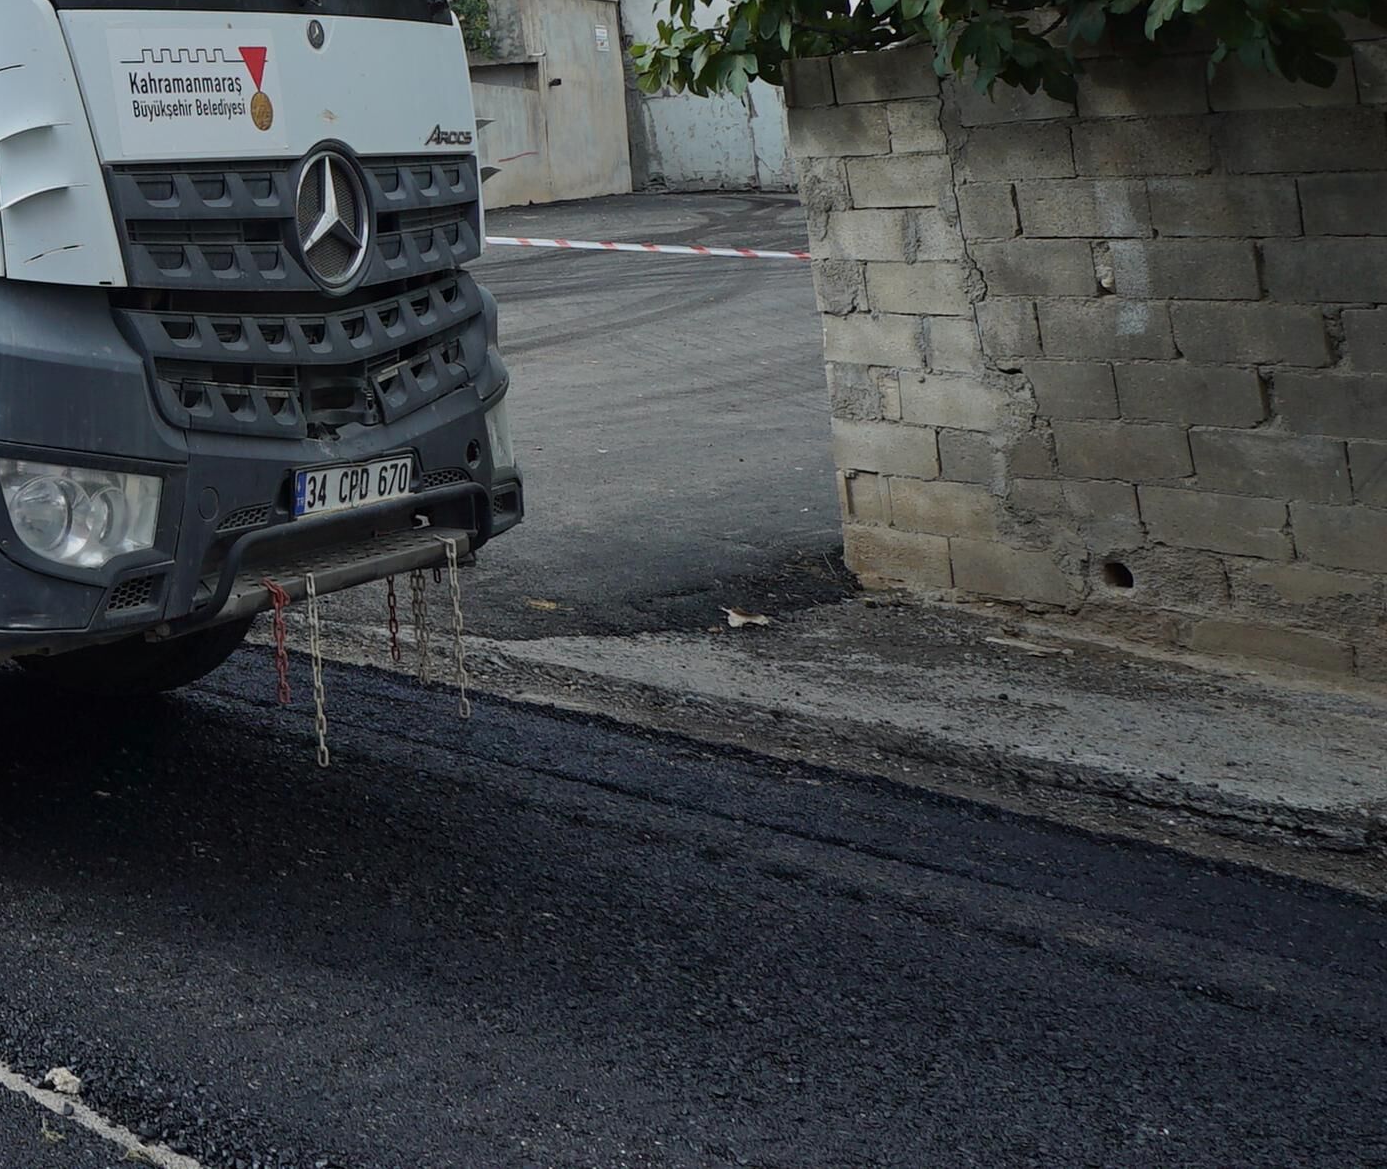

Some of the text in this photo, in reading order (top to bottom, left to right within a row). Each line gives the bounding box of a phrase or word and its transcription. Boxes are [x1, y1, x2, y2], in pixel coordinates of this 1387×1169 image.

[128, 71, 242, 97] Kahramanmaraş
[132, 97, 246, 122] Büyükşehir Belediyesi
[307, 473, 328, 509] 34
[338, 467, 370, 504] CPD
[378, 462, 409, 497] 670
